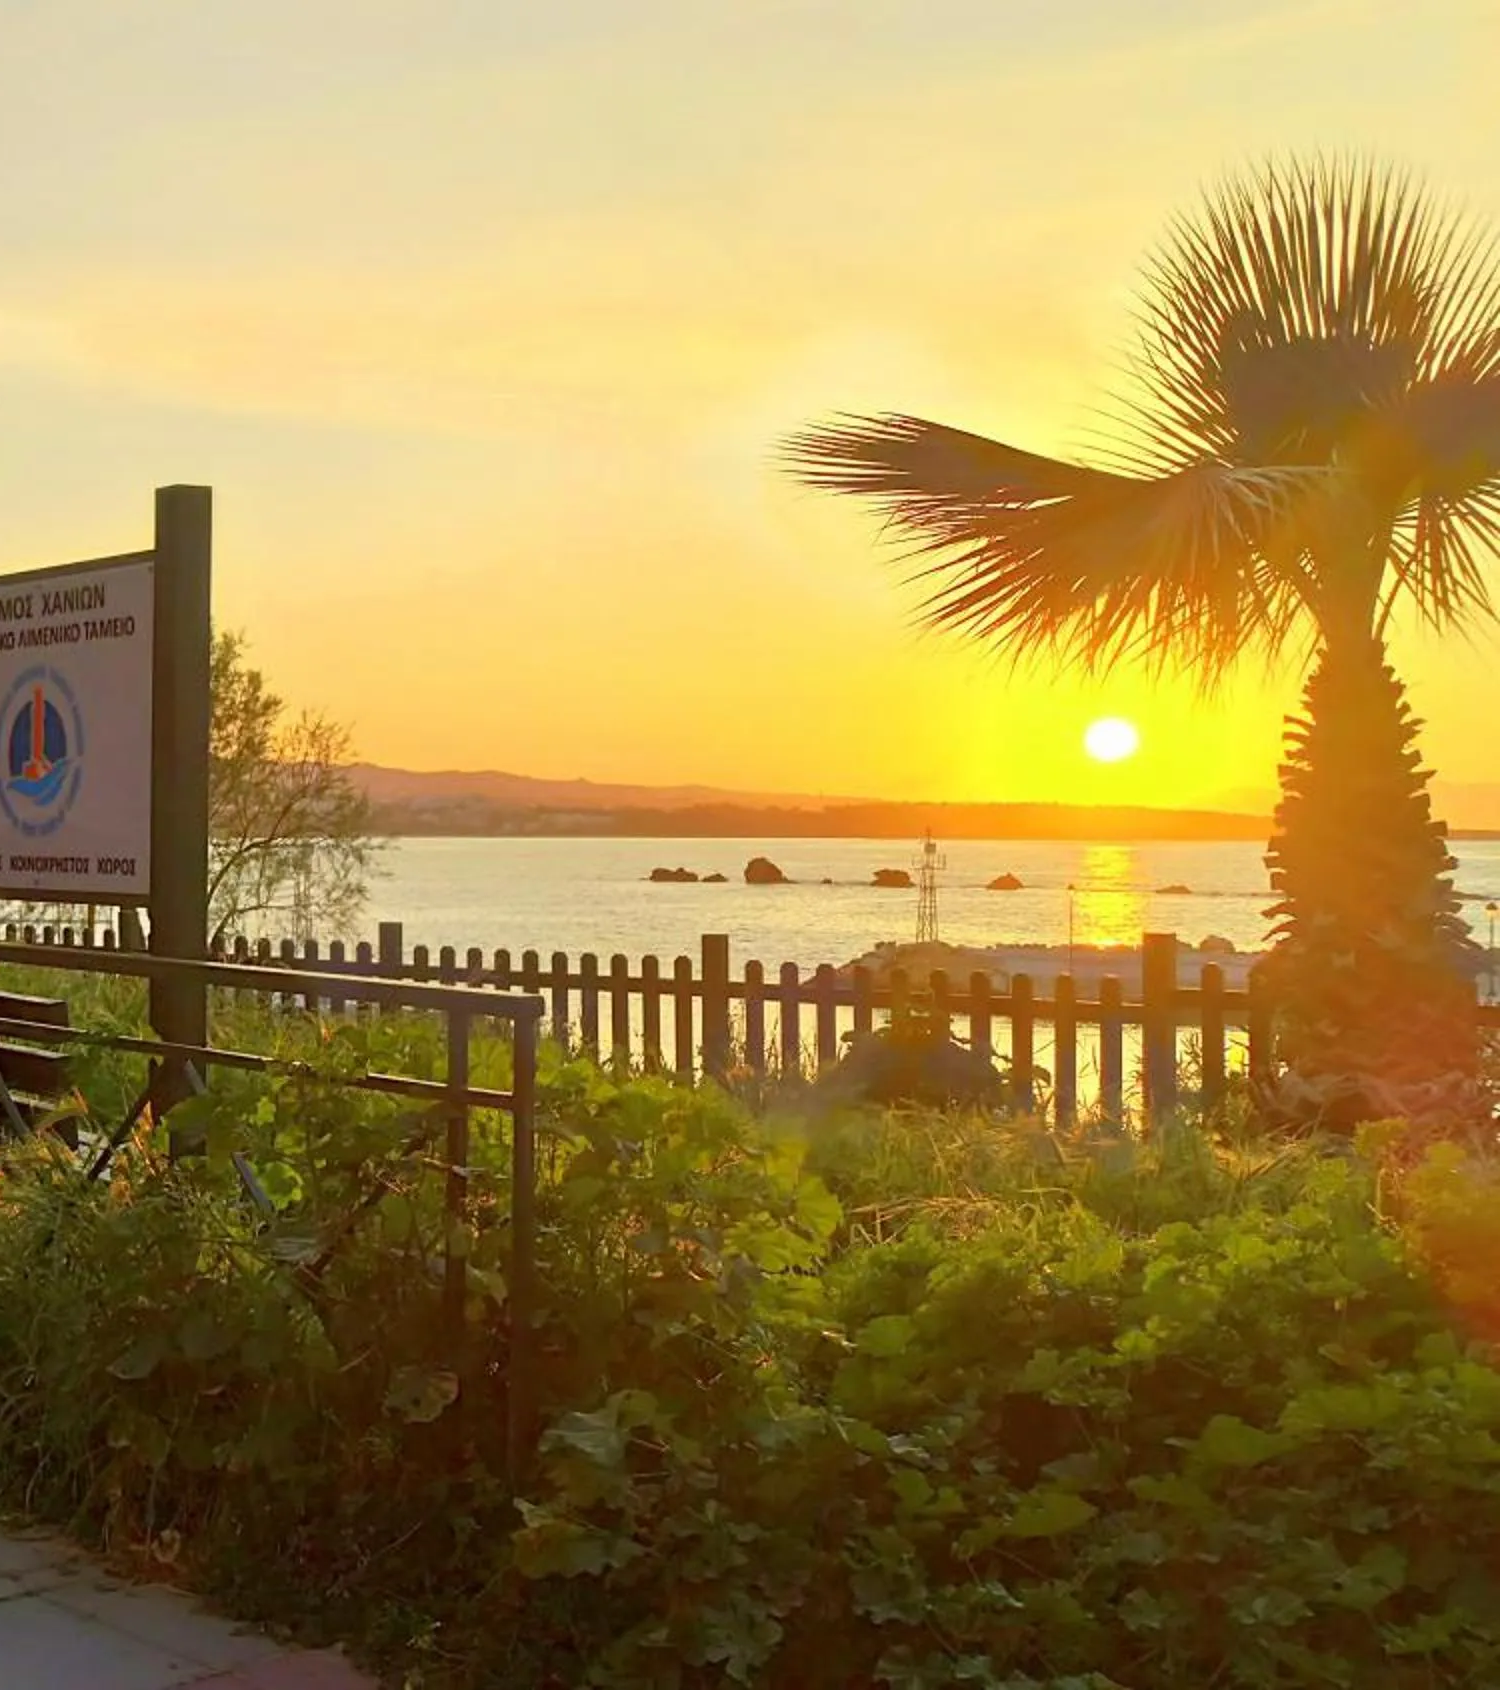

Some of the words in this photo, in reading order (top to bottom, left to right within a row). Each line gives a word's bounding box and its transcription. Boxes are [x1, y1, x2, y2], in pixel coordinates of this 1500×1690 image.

[41, 584, 106, 616] ΧΑΝΙΩΝ
[17, 622, 81, 649] ΛΙΜΕΝΙΚΟ
[83, 616, 136, 641] ΤΑΜΕΙΟ
[97, 857, 137, 877] ΧΩΡΟΣ
